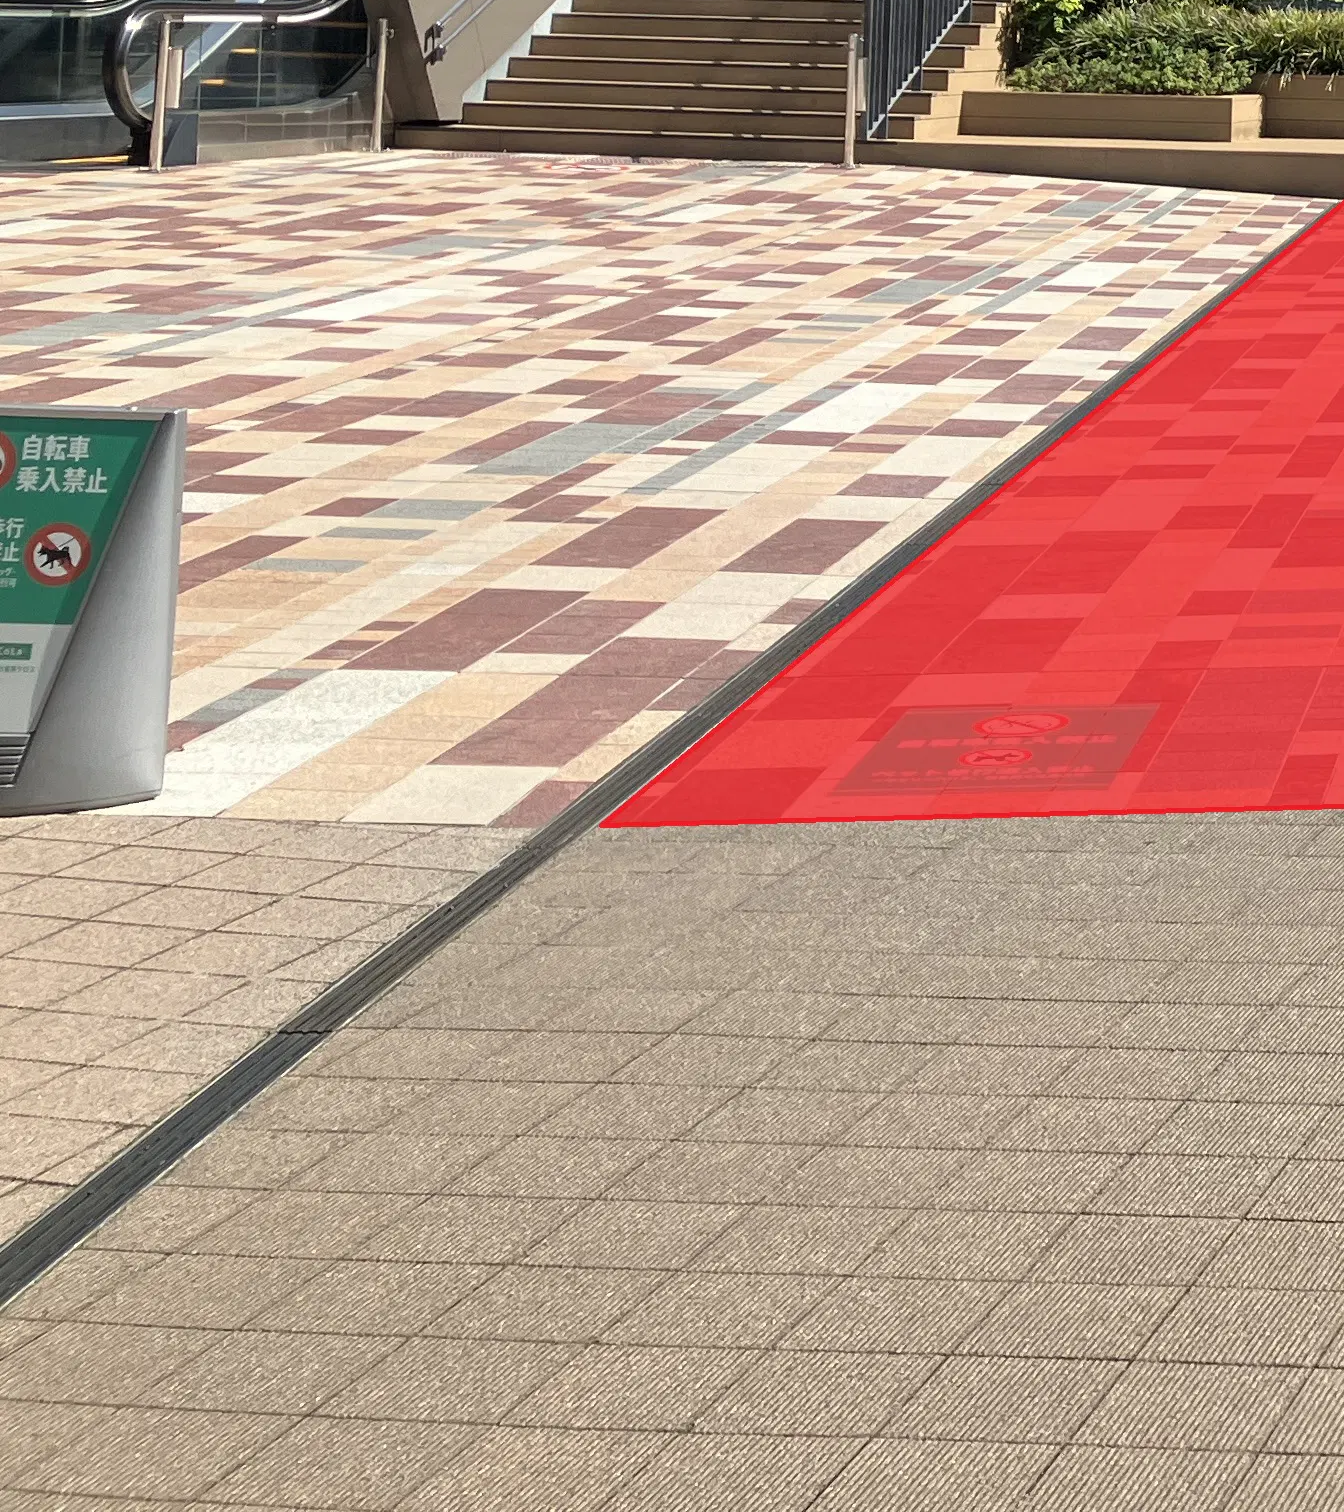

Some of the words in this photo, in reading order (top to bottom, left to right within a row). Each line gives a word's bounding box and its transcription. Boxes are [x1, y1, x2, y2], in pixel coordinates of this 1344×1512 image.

[22, 434, 91, 462] 自転車
[16, 466, 108, 493] 乗入禁止
